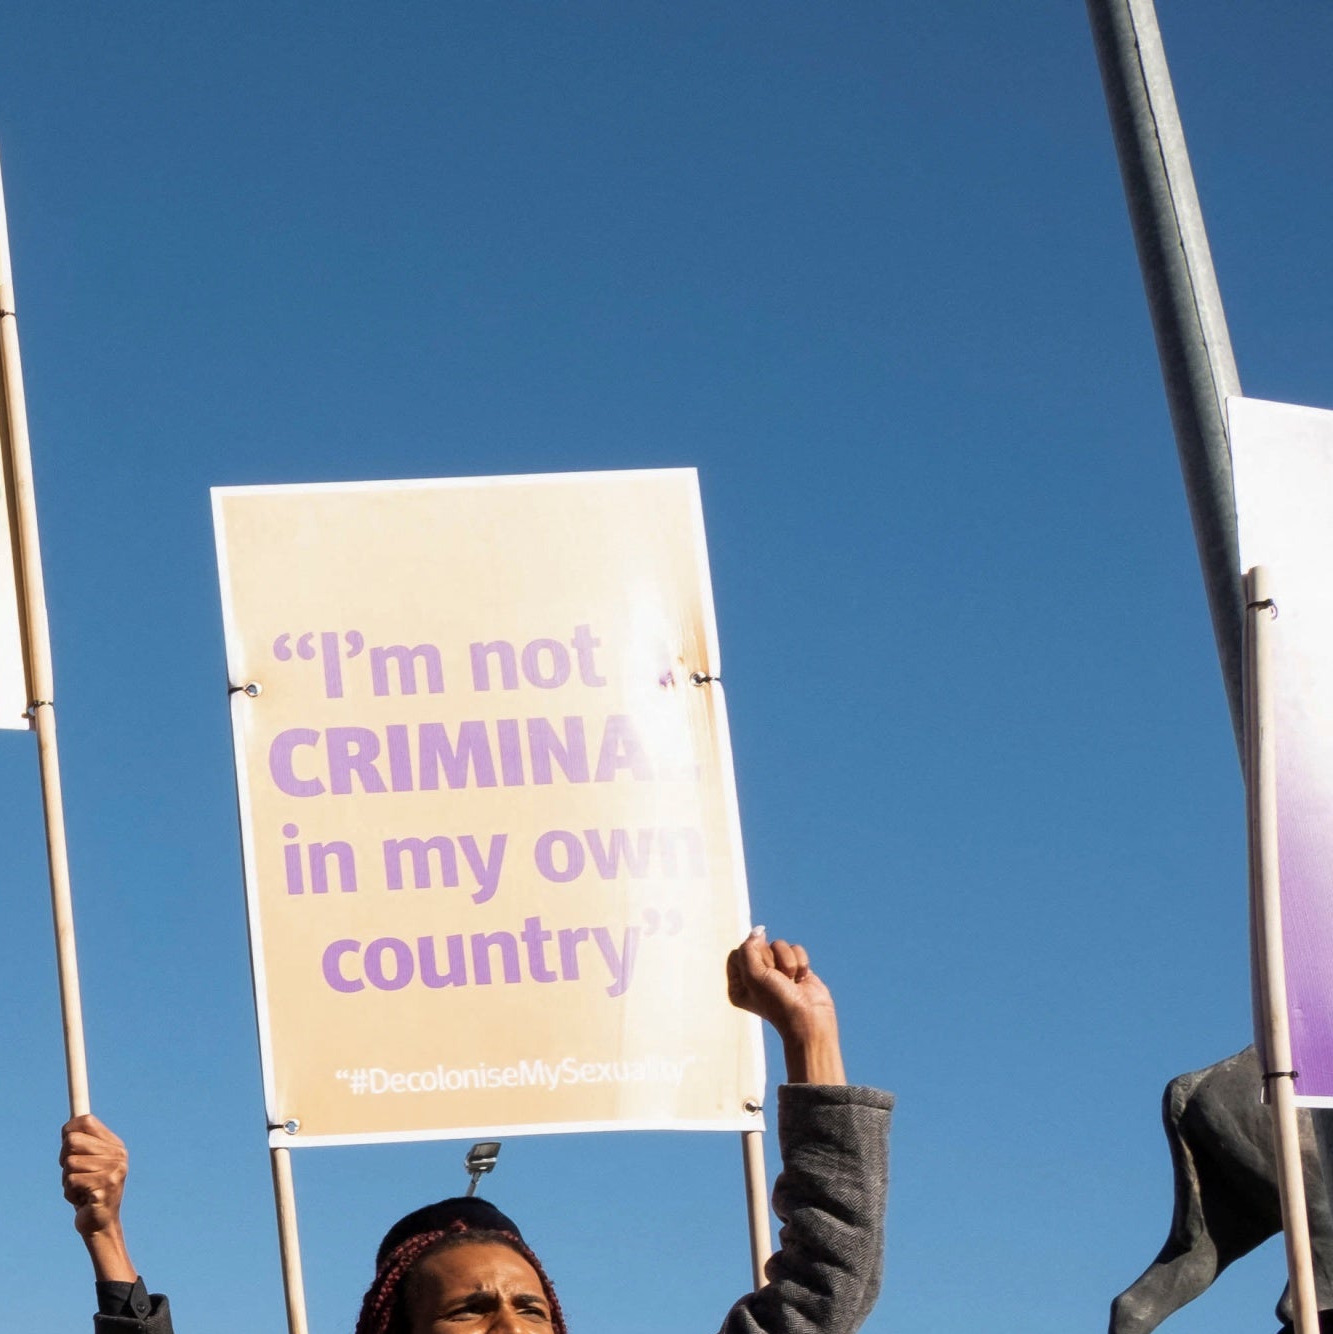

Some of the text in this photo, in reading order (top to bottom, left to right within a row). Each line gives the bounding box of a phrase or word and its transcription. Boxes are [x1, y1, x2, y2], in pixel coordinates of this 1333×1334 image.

[272, 624, 607, 698] “I’m not
[268, 714, 701, 798] CRIMINA
[282, 823, 708, 905] in my own
[321, 907, 683, 998] country”
